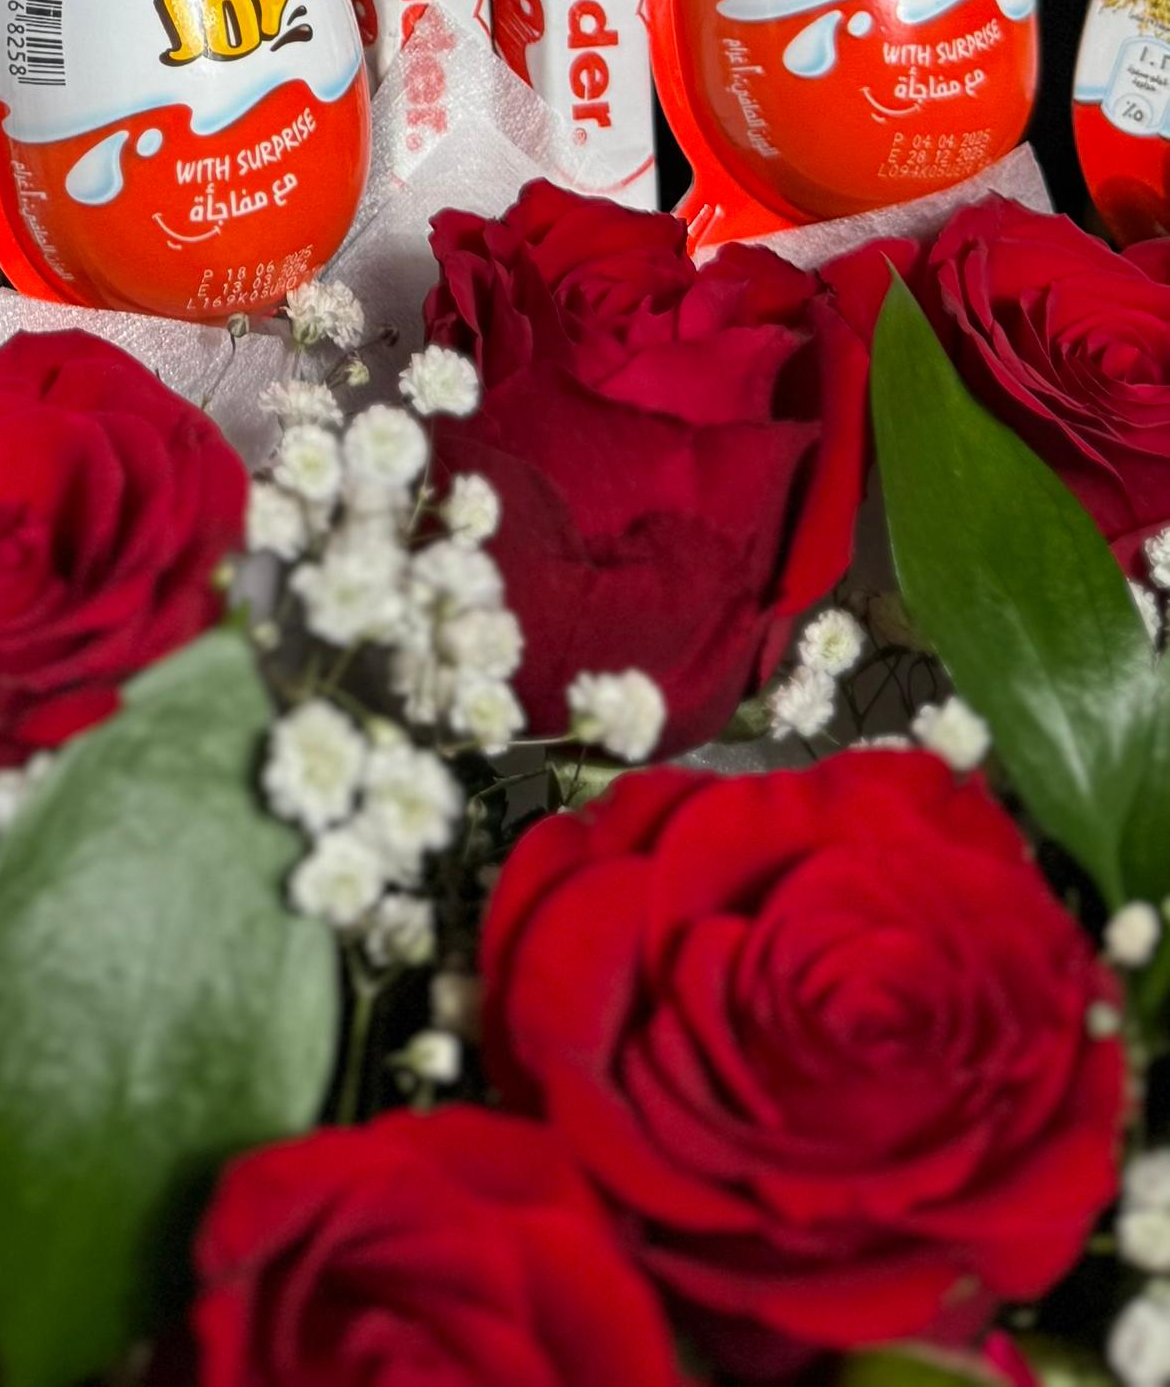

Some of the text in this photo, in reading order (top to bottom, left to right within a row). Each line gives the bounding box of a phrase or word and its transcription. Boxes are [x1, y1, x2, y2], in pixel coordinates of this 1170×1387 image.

[6, 22, 27, 76] 8258
[883, 18, 1003, 67] WITH SURPRISE
[894, 65, 987, 104] مع مفاجأة
[176, 107, 317, 185] WITH SURPRISE
[887, 148, 902, 164] E
[907, 149, 927, 165] 28
[893, 131, 905, 146] P
[912, 133, 932, 150] 04
[938, 133, 955, 149] 04
[190, 172, 299, 226] مع مفاجأة
[197, 283, 210, 297] E
[222, 280, 243, 296] 13
[252, 275, 272, 290] 03
[201, 268, 214, 284] P
[227, 266, 247, 282] 18
[255, 259, 276, 277] 06
